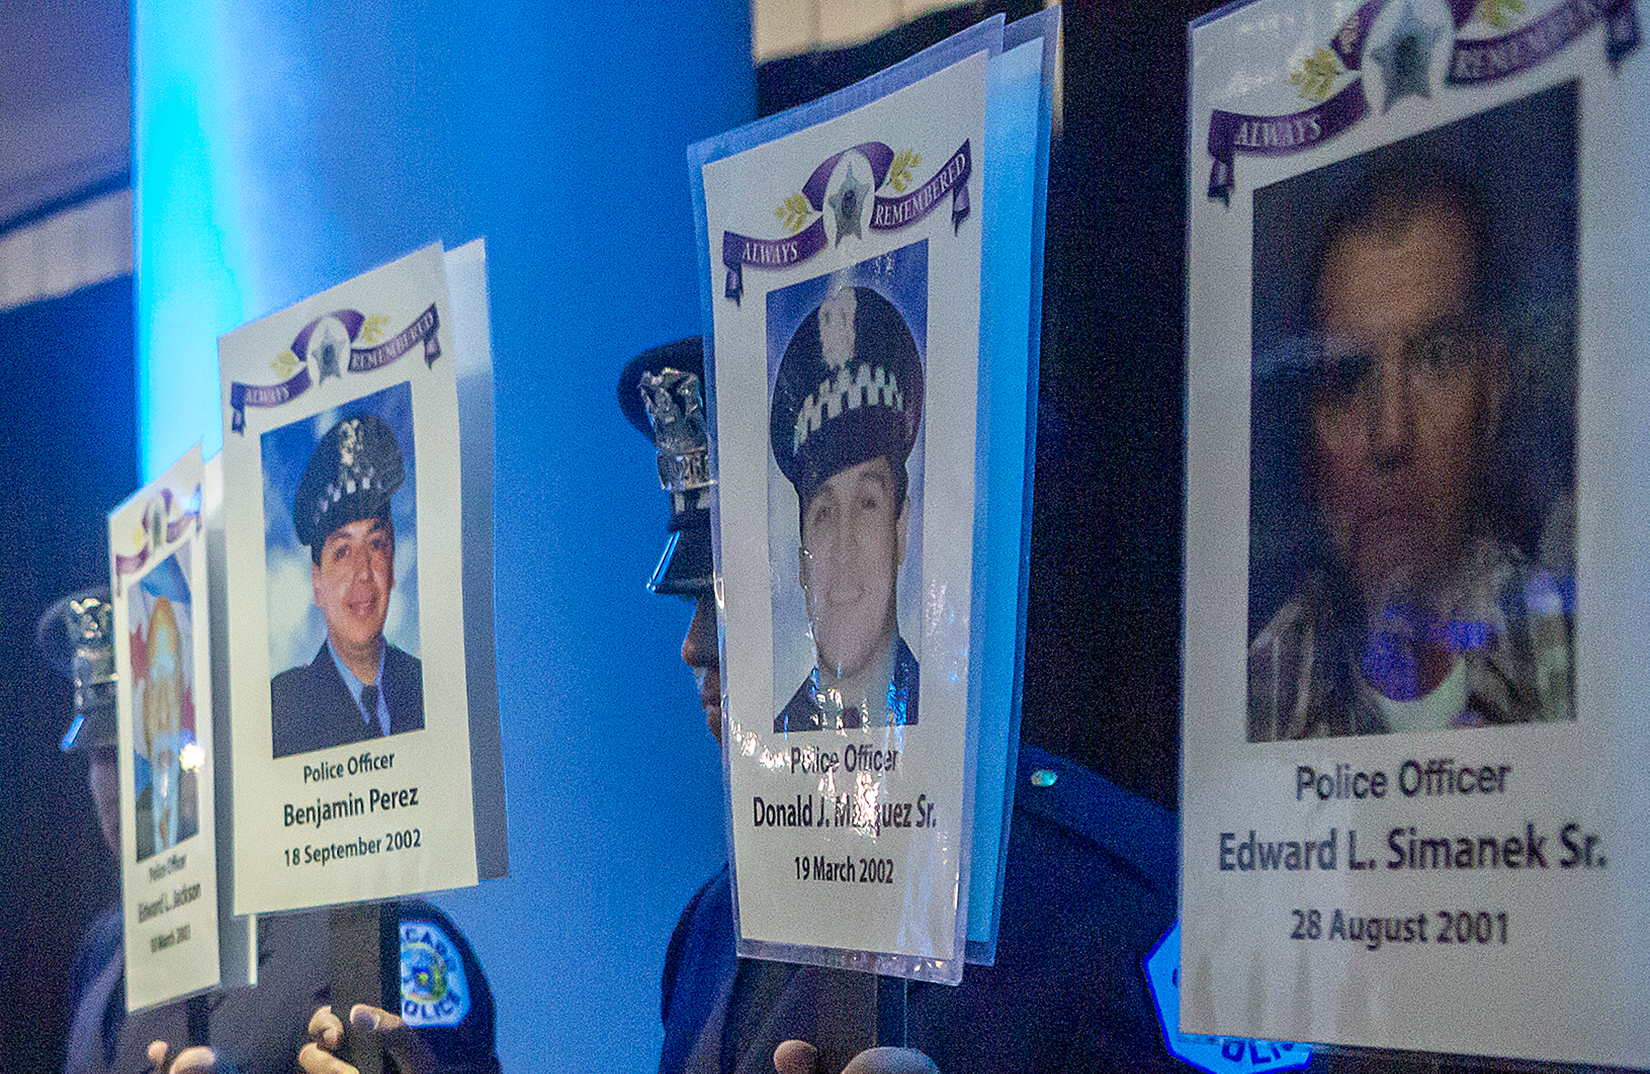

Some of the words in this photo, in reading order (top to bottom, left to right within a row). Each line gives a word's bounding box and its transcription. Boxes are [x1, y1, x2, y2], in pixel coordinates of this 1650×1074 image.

[1235, 114, 1321, 148] ALWAYS
[741, 241, 798, 264] ALWAYS
[874, 152, 966, 227] REMEMBERED
[303, 762, 344, 784] Police
[347, 751, 395, 776] Officer
[791, 746, 840, 774] Police
[844, 743, 899, 773] Officer
[1295, 764, 1388, 801] Police
[1398, 757, 1513, 798] Officer
[283, 792, 365, 829] Benjamin
[369, 786, 420, 813] Perez
[753, 794, 813, 828] Donald
[817, 796, 830, 828] J.
[835, 794, 912, 837] Mquez
[915, 793, 938, 829] Sr.
[284, 847, 301, 867] 18
[304, 836, 382, 867] September
[385, 827, 422, 852] 2002
[1218, 828, 1338, 873] Edward
[1348, 829, 1378, 872] L.
[1386, 822, 1550, 872] Simanek
[1558, 821, 1608, 871] Sr.
[794, 856, 810, 881] 19
[813, 855, 856, 883] March
[859, 857, 894, 885] 2002
[1289, 908, 1322, 941] 28
[1328, 908, 1429, 951] August
[1436, 910, 1510, 946] 2001
[403, 989, 462, 1020] OLICE
